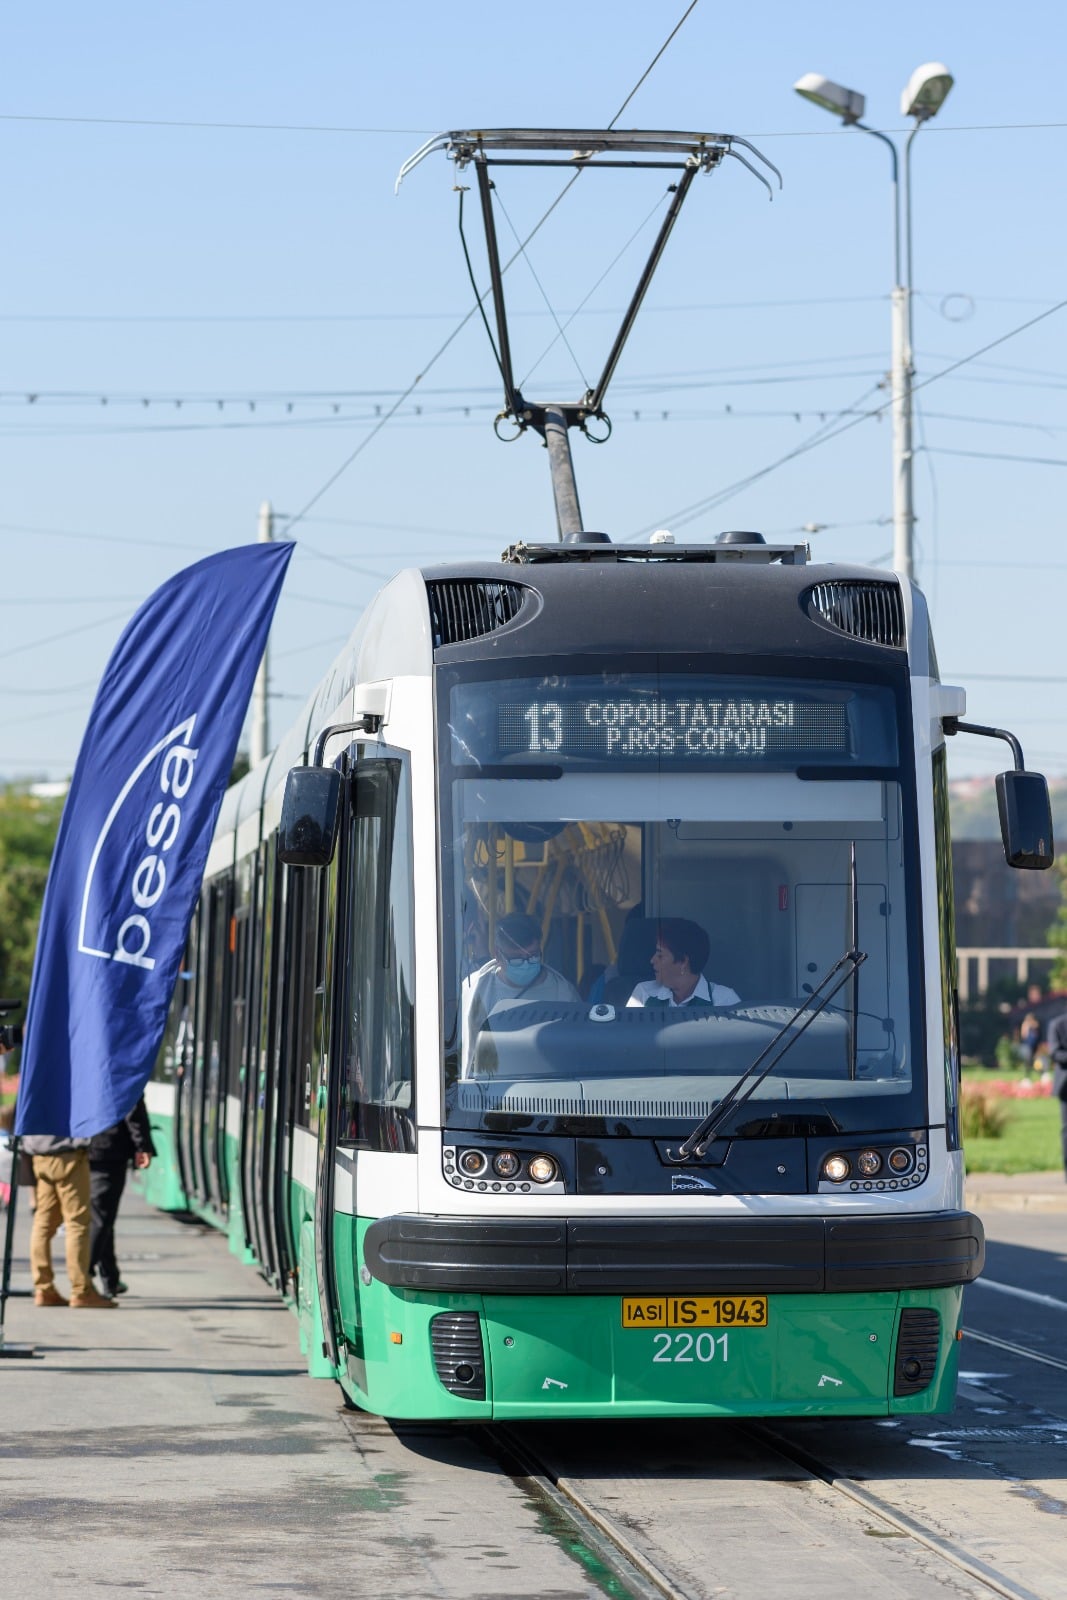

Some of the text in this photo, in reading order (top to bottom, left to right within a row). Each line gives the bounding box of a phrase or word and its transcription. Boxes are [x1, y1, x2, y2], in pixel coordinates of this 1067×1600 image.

[524, 703, 562, 750] 13
[585, 703, 794, 725] COPOU-TATARASI
[112, 744, 199, 970] pesa
[627, 1304, 662, 1321] IASI
[652, 1332, 729, 1362] 2201
